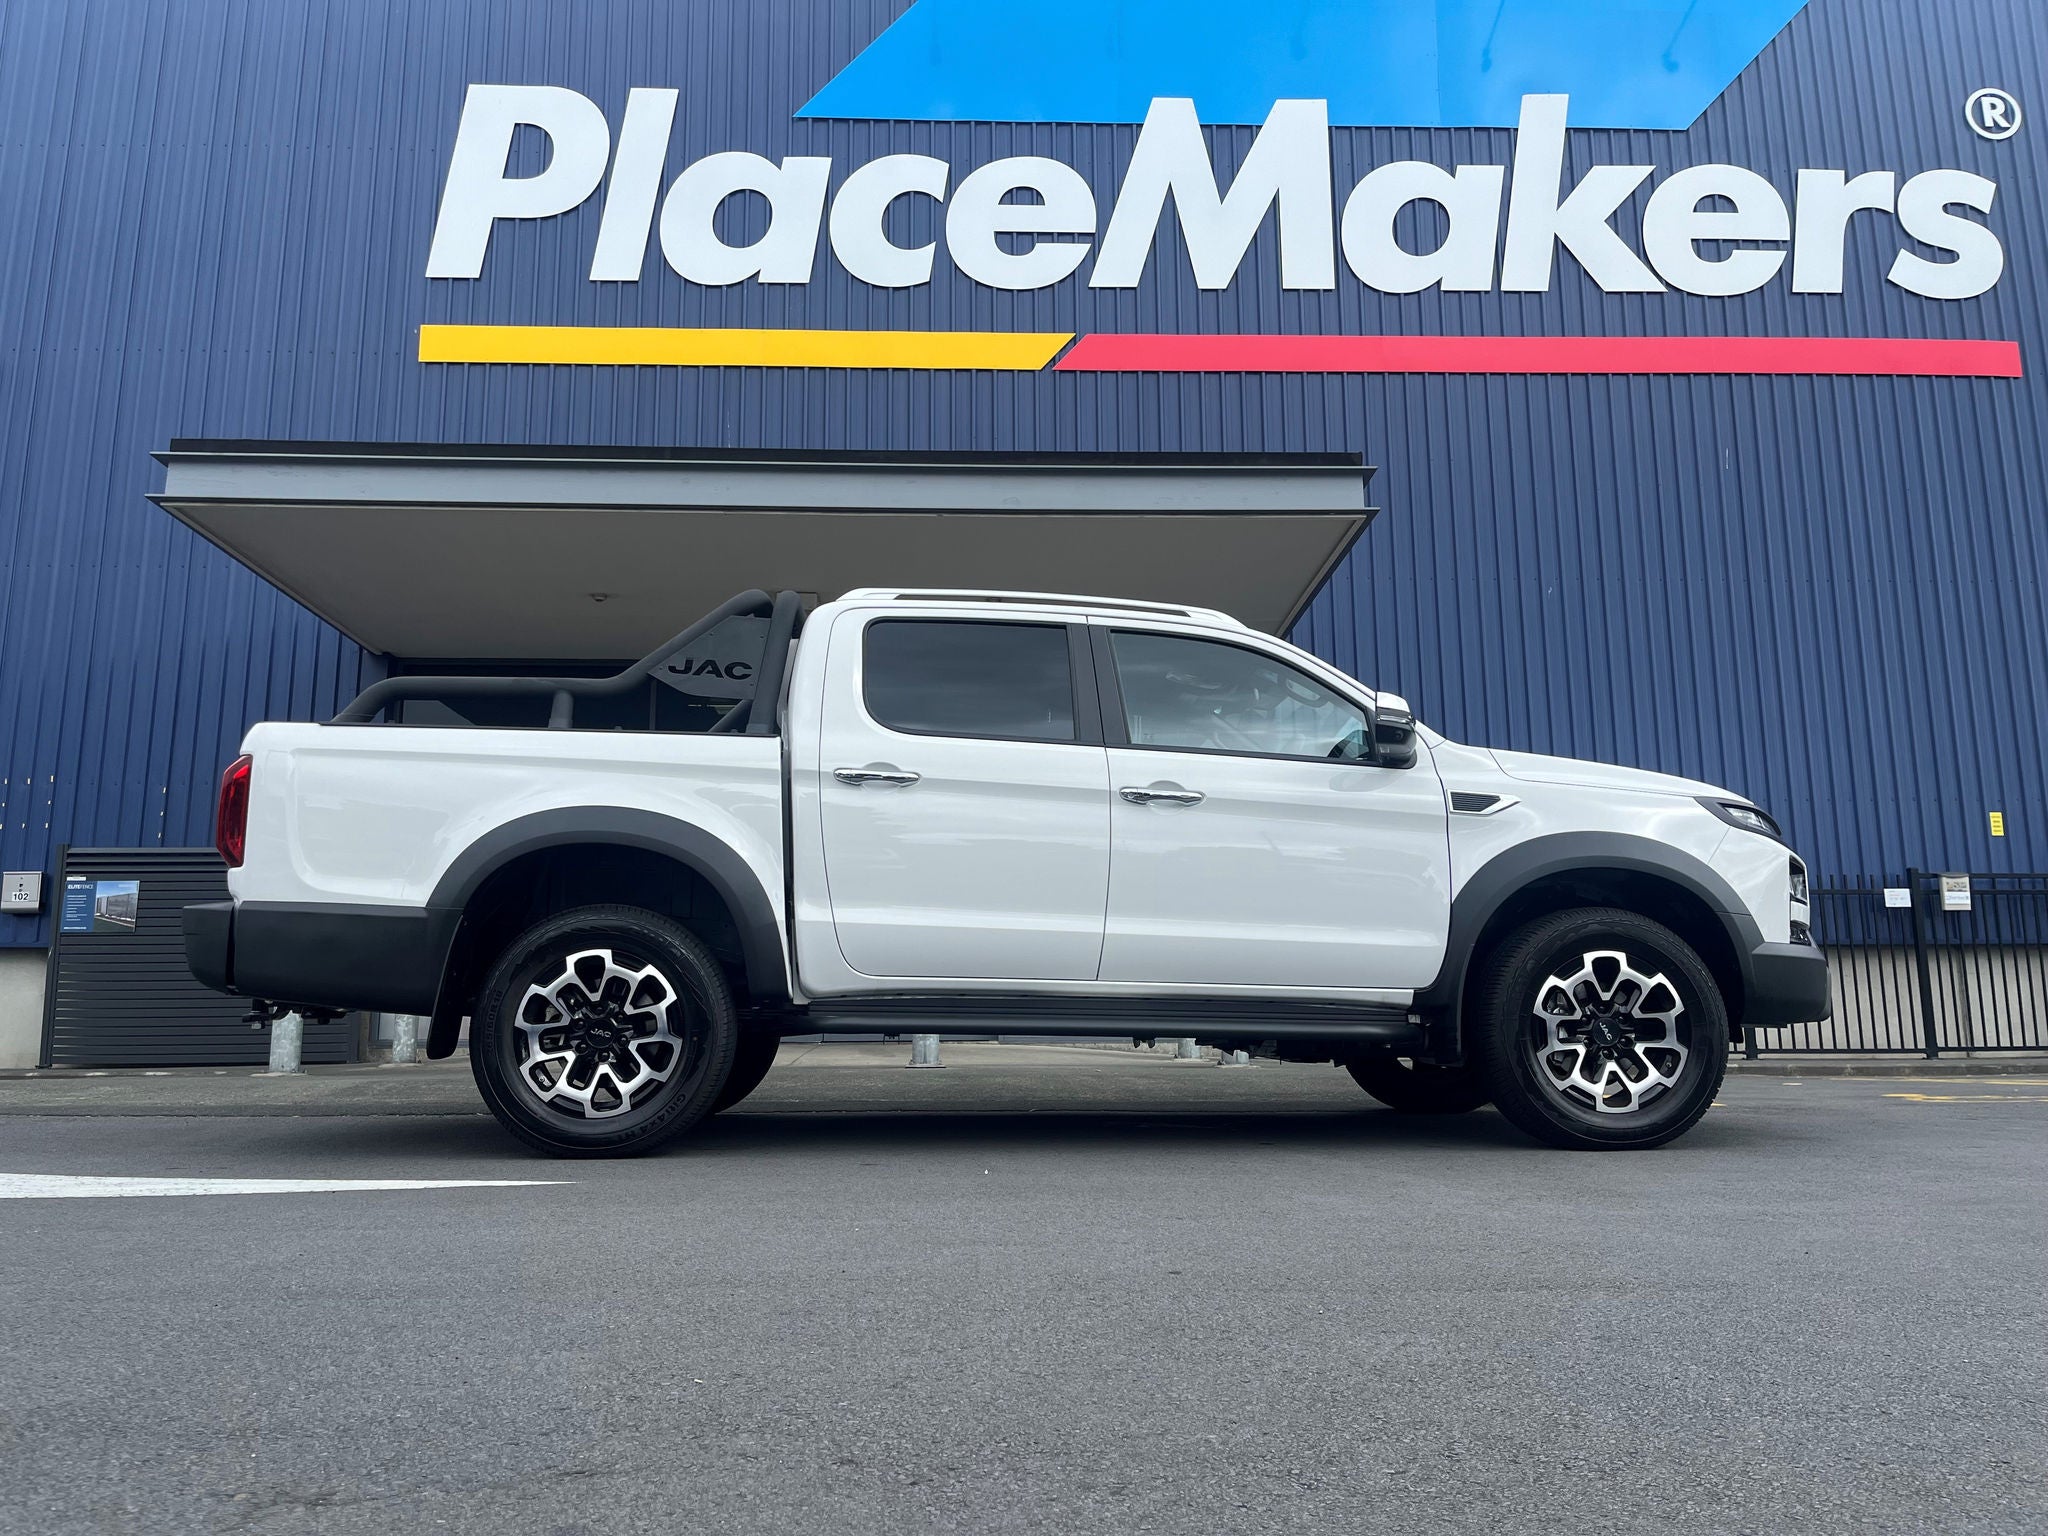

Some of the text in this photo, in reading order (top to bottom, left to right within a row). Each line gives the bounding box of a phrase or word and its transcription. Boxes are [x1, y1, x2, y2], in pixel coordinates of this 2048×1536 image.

[425, 84, 2004, 300] PlaceMakers
[667, 657, 753, 680] JAC
[13, 892, 29, 901] 102
[590, 1028, 612, 1038] JAC
[1599, 1022, 1613, 1041] JAC
